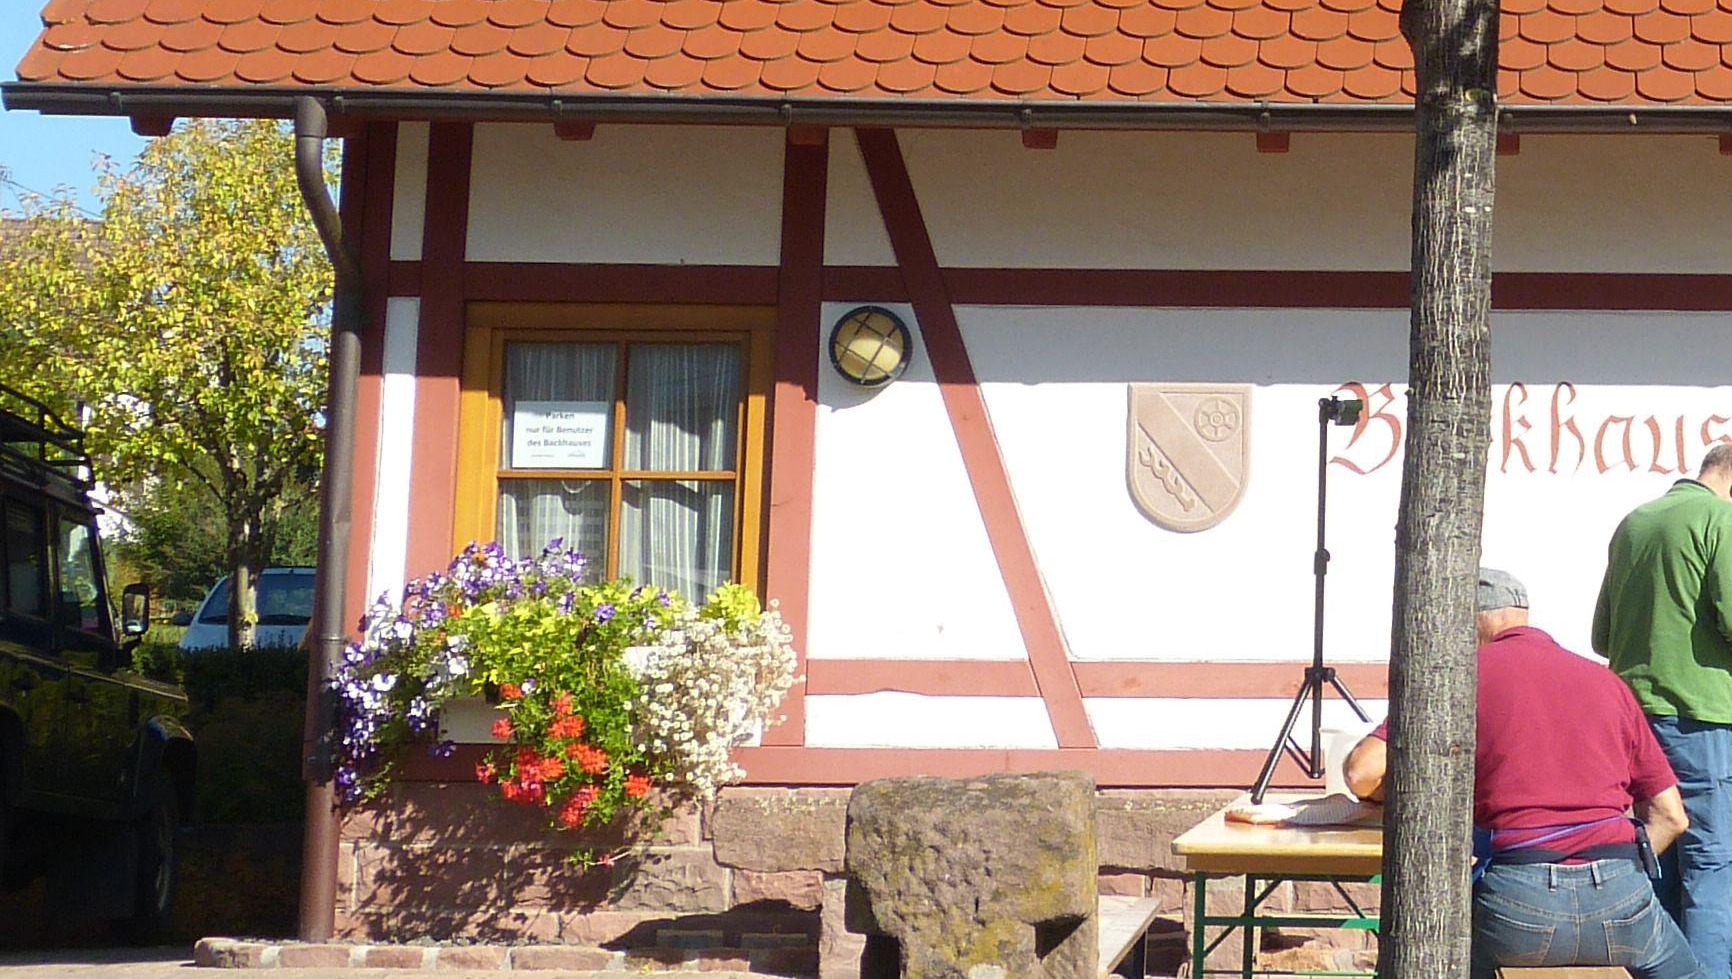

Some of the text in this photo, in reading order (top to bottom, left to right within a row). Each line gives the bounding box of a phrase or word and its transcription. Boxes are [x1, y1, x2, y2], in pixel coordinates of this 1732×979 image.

[545, 412, 575, 420] Parken
[556, 426, 593, 434] Benutzer
[543, 439, 592, 447] Backhauses
